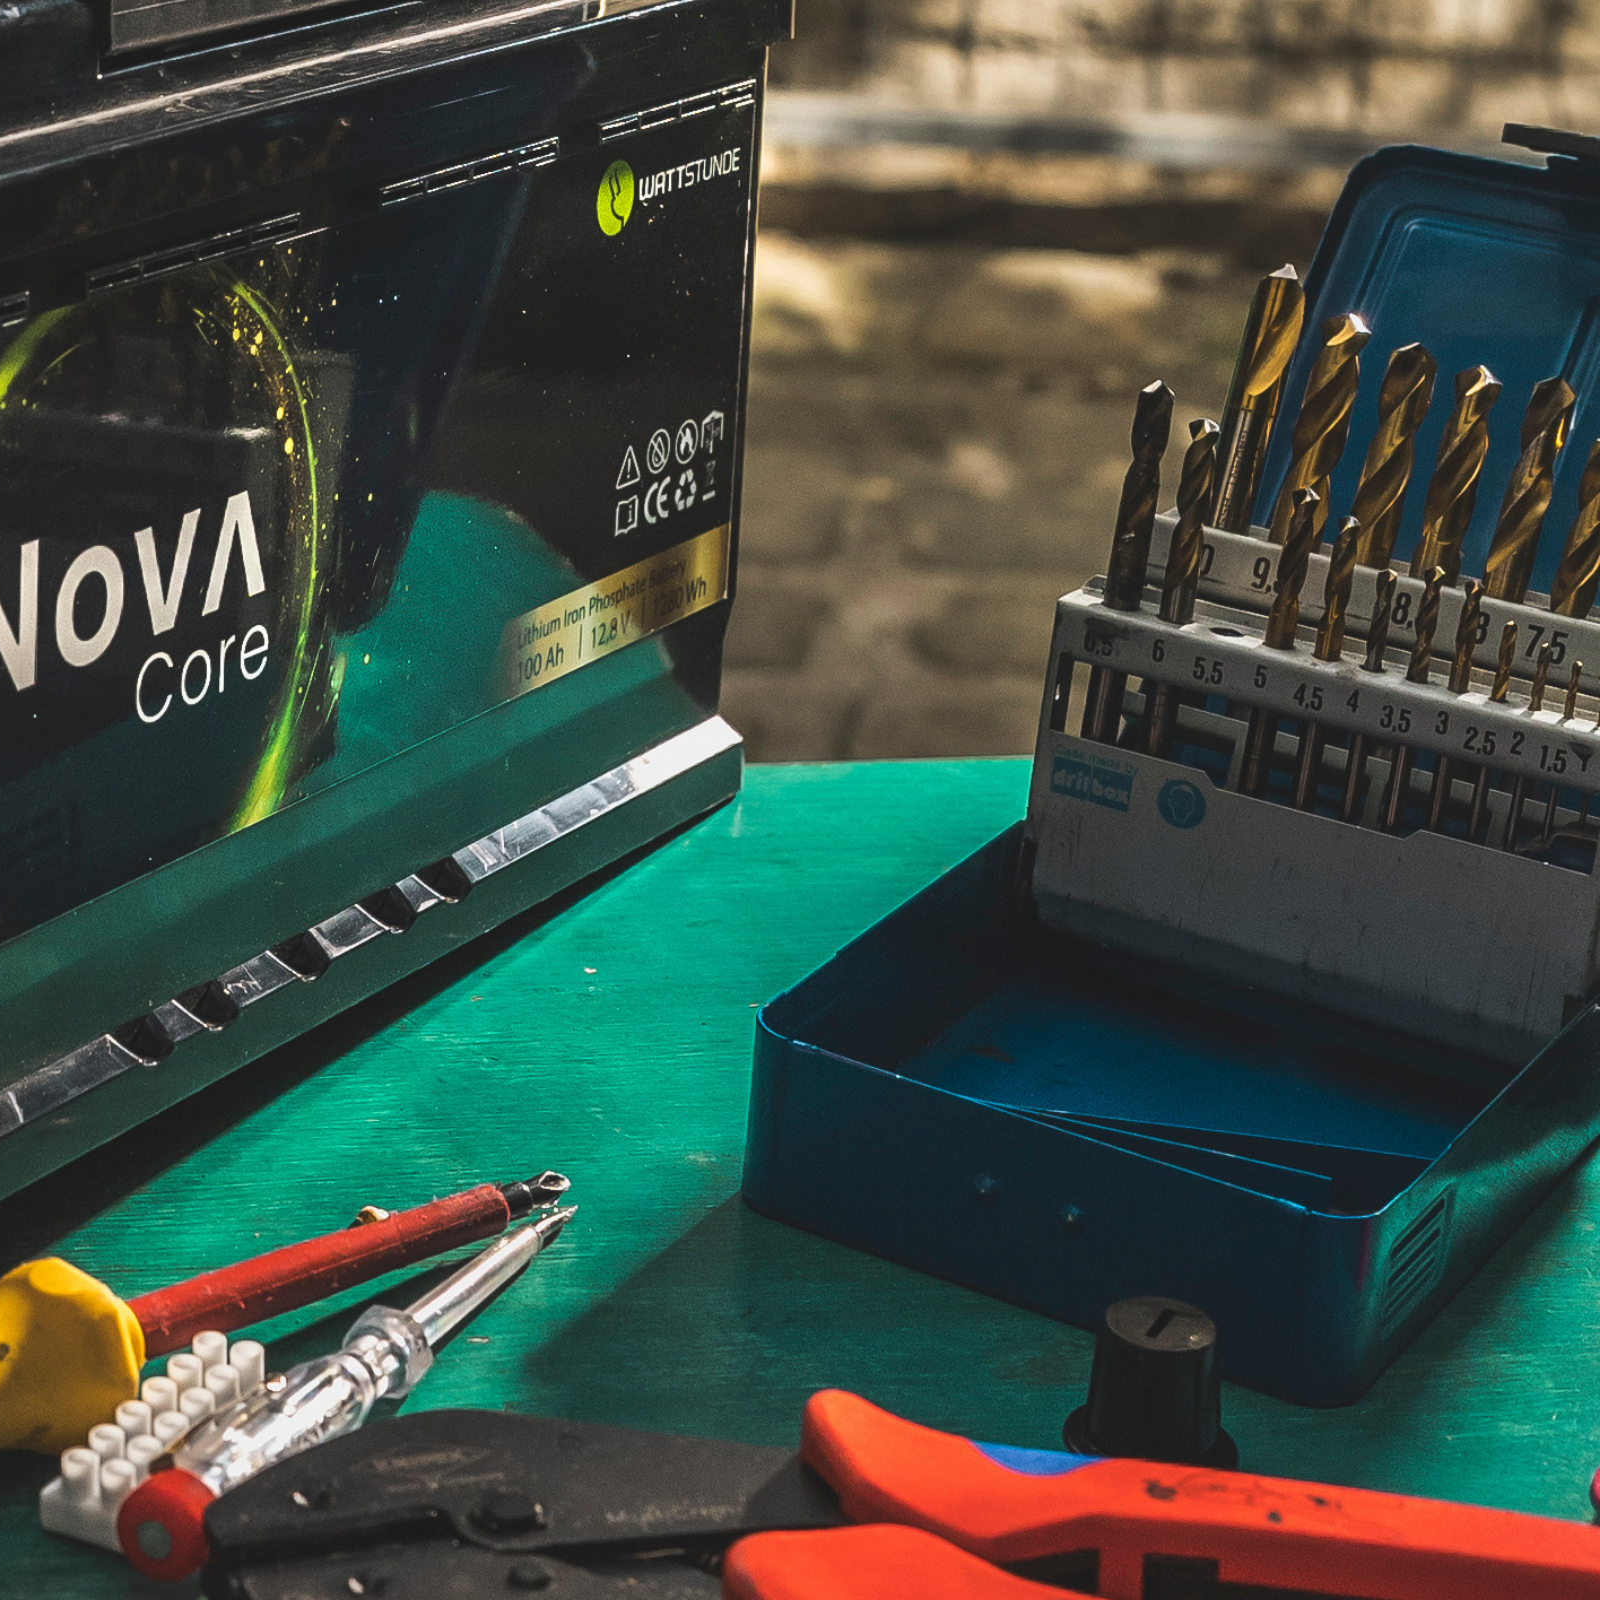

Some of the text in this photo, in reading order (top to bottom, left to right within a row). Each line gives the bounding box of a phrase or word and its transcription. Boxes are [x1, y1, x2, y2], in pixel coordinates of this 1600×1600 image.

[639, 147, 741, 200] WATTSTUNDE
[518, 616, 561, 650] Lithium
[564, 605, 586, 629] Iron
[589, 578, 646, 617] Phosphate
[518, 652, 542, 683] 100
[545, 642, 564, 671] Ah
[591, 616, 618, 649] 12,8
[620, 610, 632, 635] V
[686, 576, 707, 604] Wh
[136, 624, 269, 723] Core
[1152, 639, 1165, 663] 6
[1192, 657, 1223, 686] 5,5
[1254, 665, 1267, 689] 5
[1293, 683, 1324, 711] 4,5
[1346, 689, 1360, 713] 4
[1379, 704, 1411, 733] 3,5
[1435, 711, 1449, 735] 3
[1463, 726, 1496, 755] 2,5
[1510, 730, 1526, 755] 2
[1540, 745, 1567, 774] 1,5
